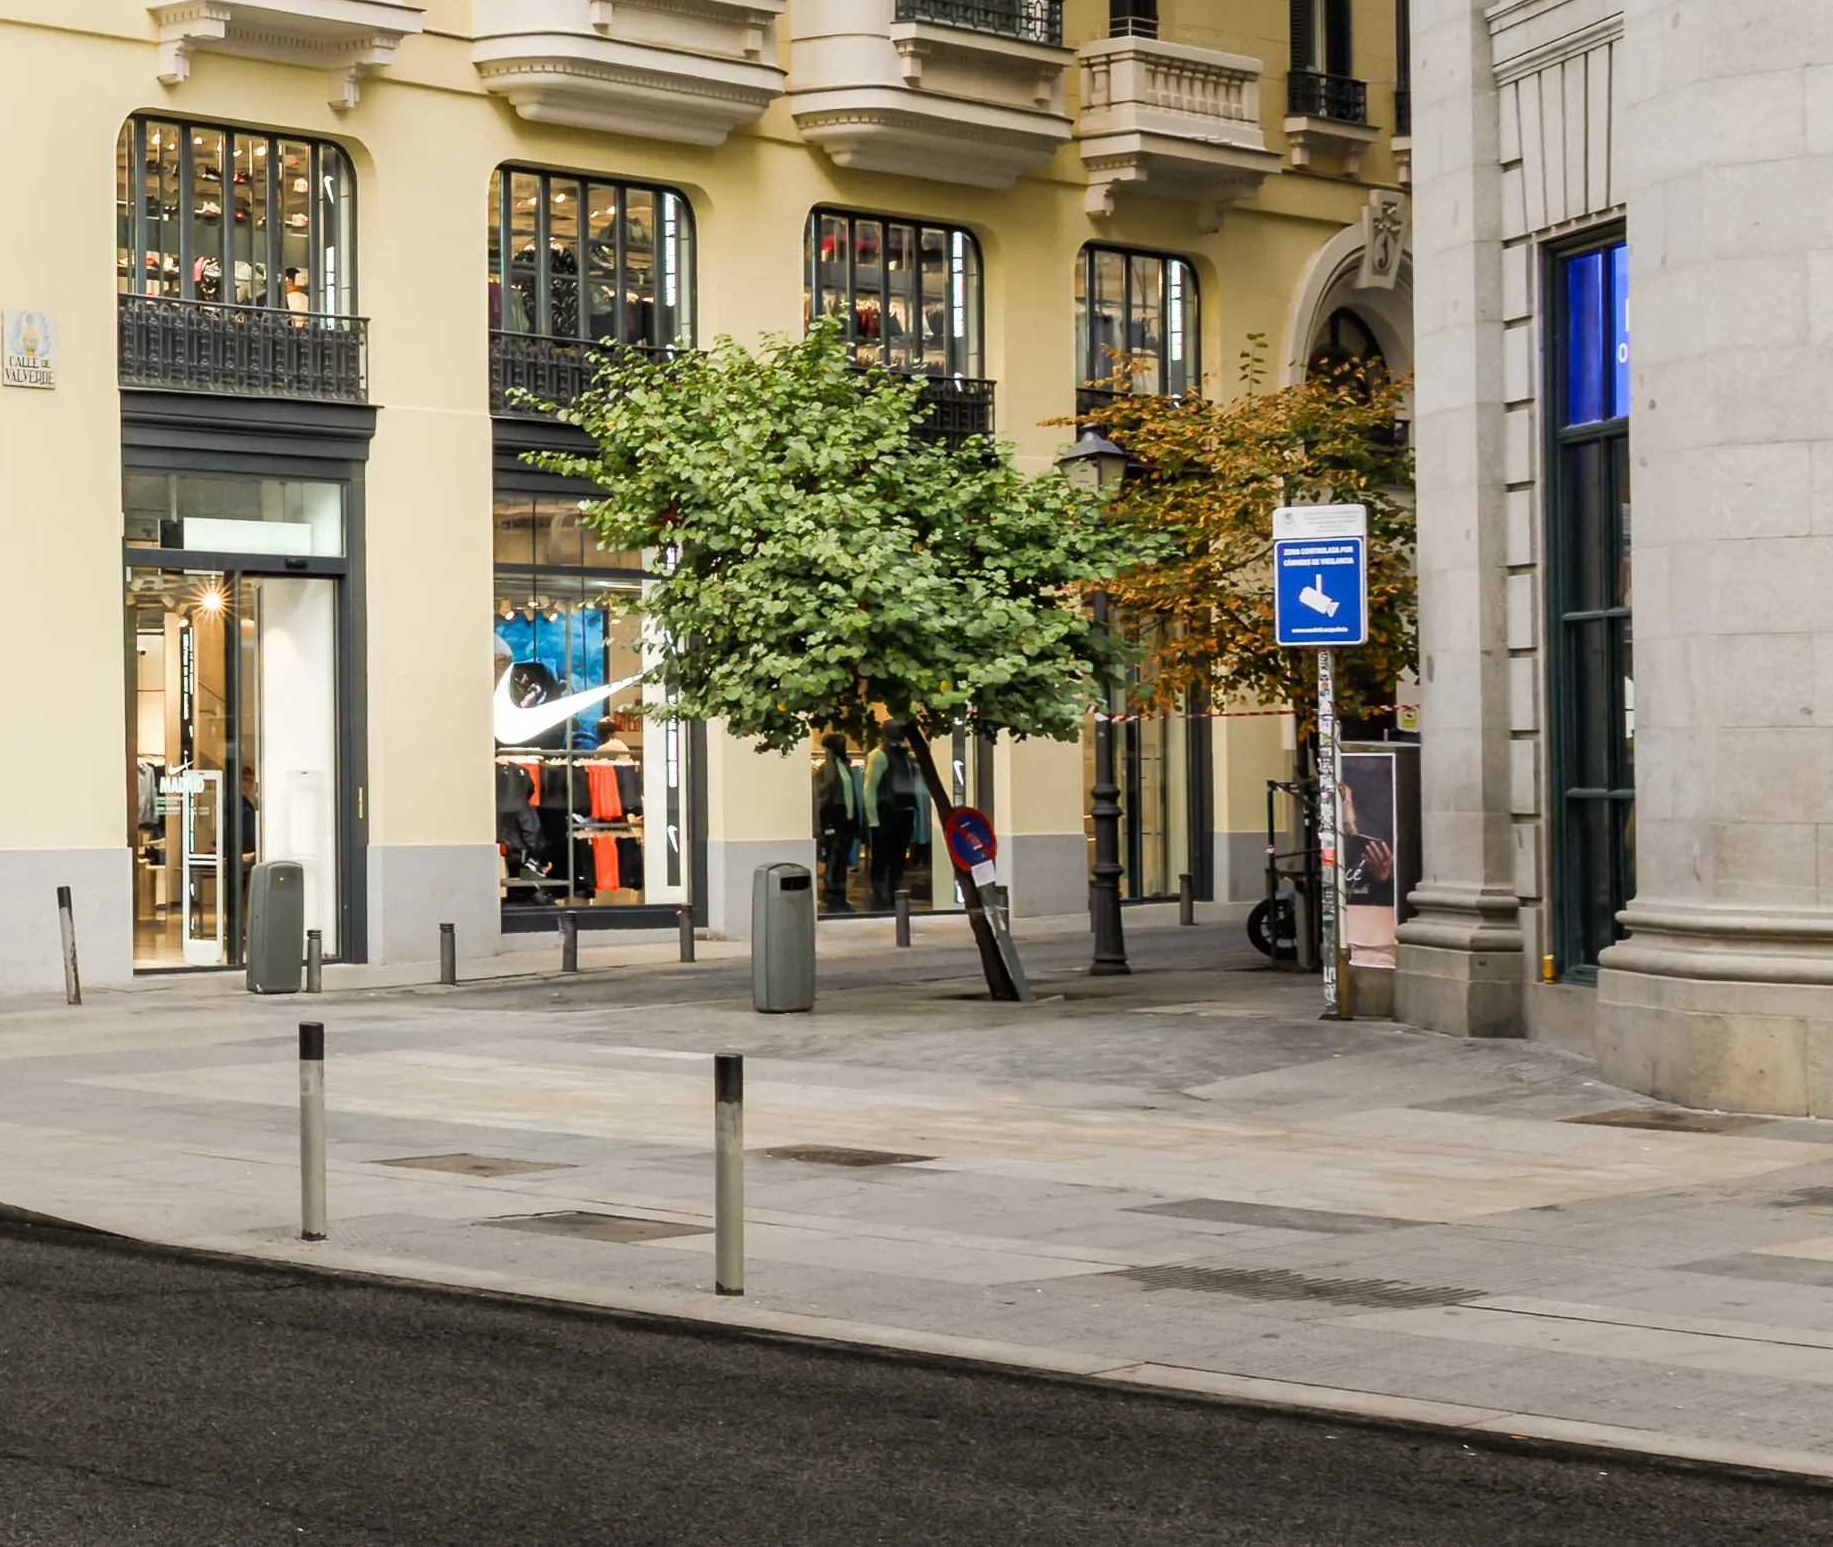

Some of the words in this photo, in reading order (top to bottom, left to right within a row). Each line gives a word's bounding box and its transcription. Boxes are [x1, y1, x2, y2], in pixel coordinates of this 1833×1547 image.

[9, 355, 39, 368] CALLE
[41, 359, 51, 368] DE
[5, 368, 55, 385] VALVERDE
